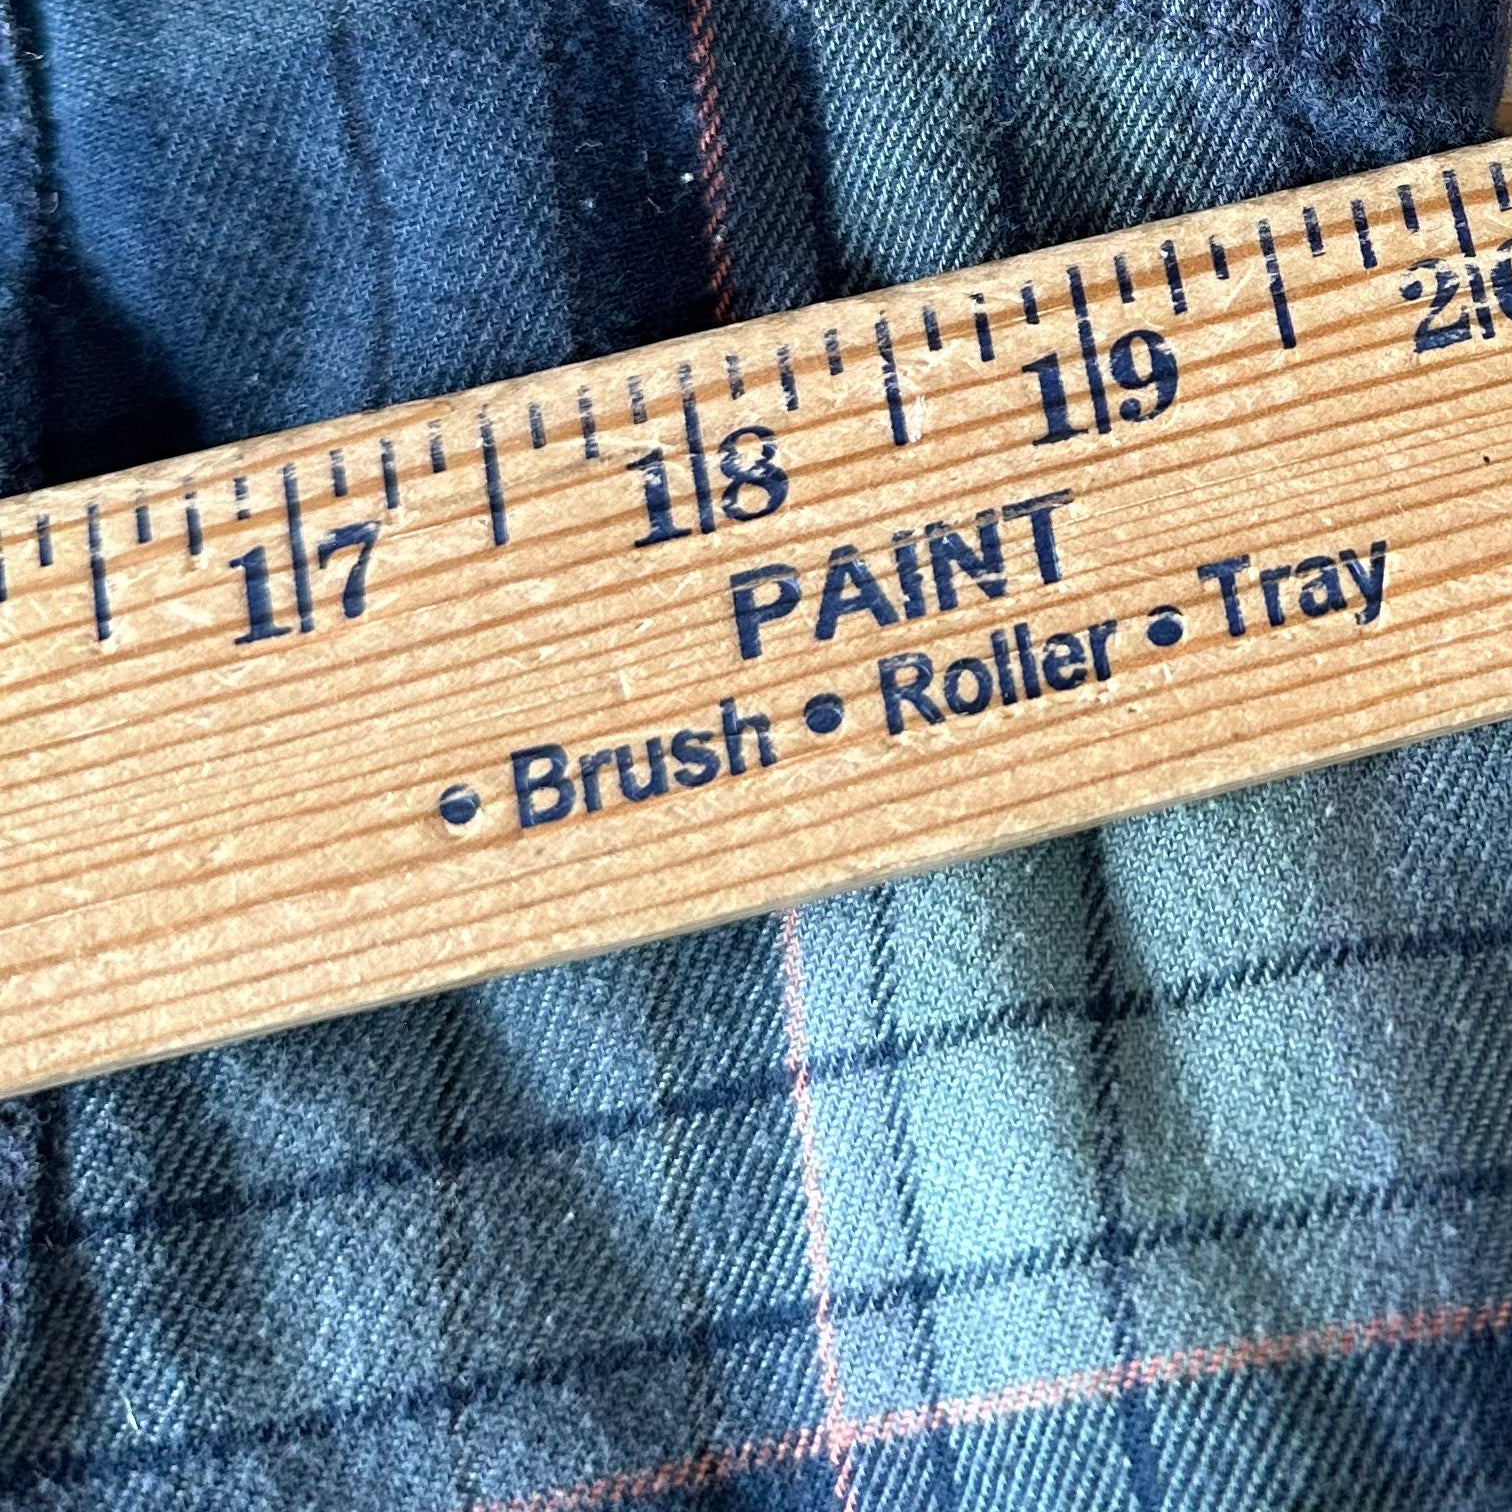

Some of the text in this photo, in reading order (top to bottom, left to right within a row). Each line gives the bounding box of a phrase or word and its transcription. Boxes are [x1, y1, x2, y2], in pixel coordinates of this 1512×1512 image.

[231, 521, 383, 645] 17
[627, 425, 790, 548] 18
[1022, 329, 1178, 447] 19
[730, 488, 1076, 660] PAINT
[510, 539, 1389, 829] Brush Roller Tray
